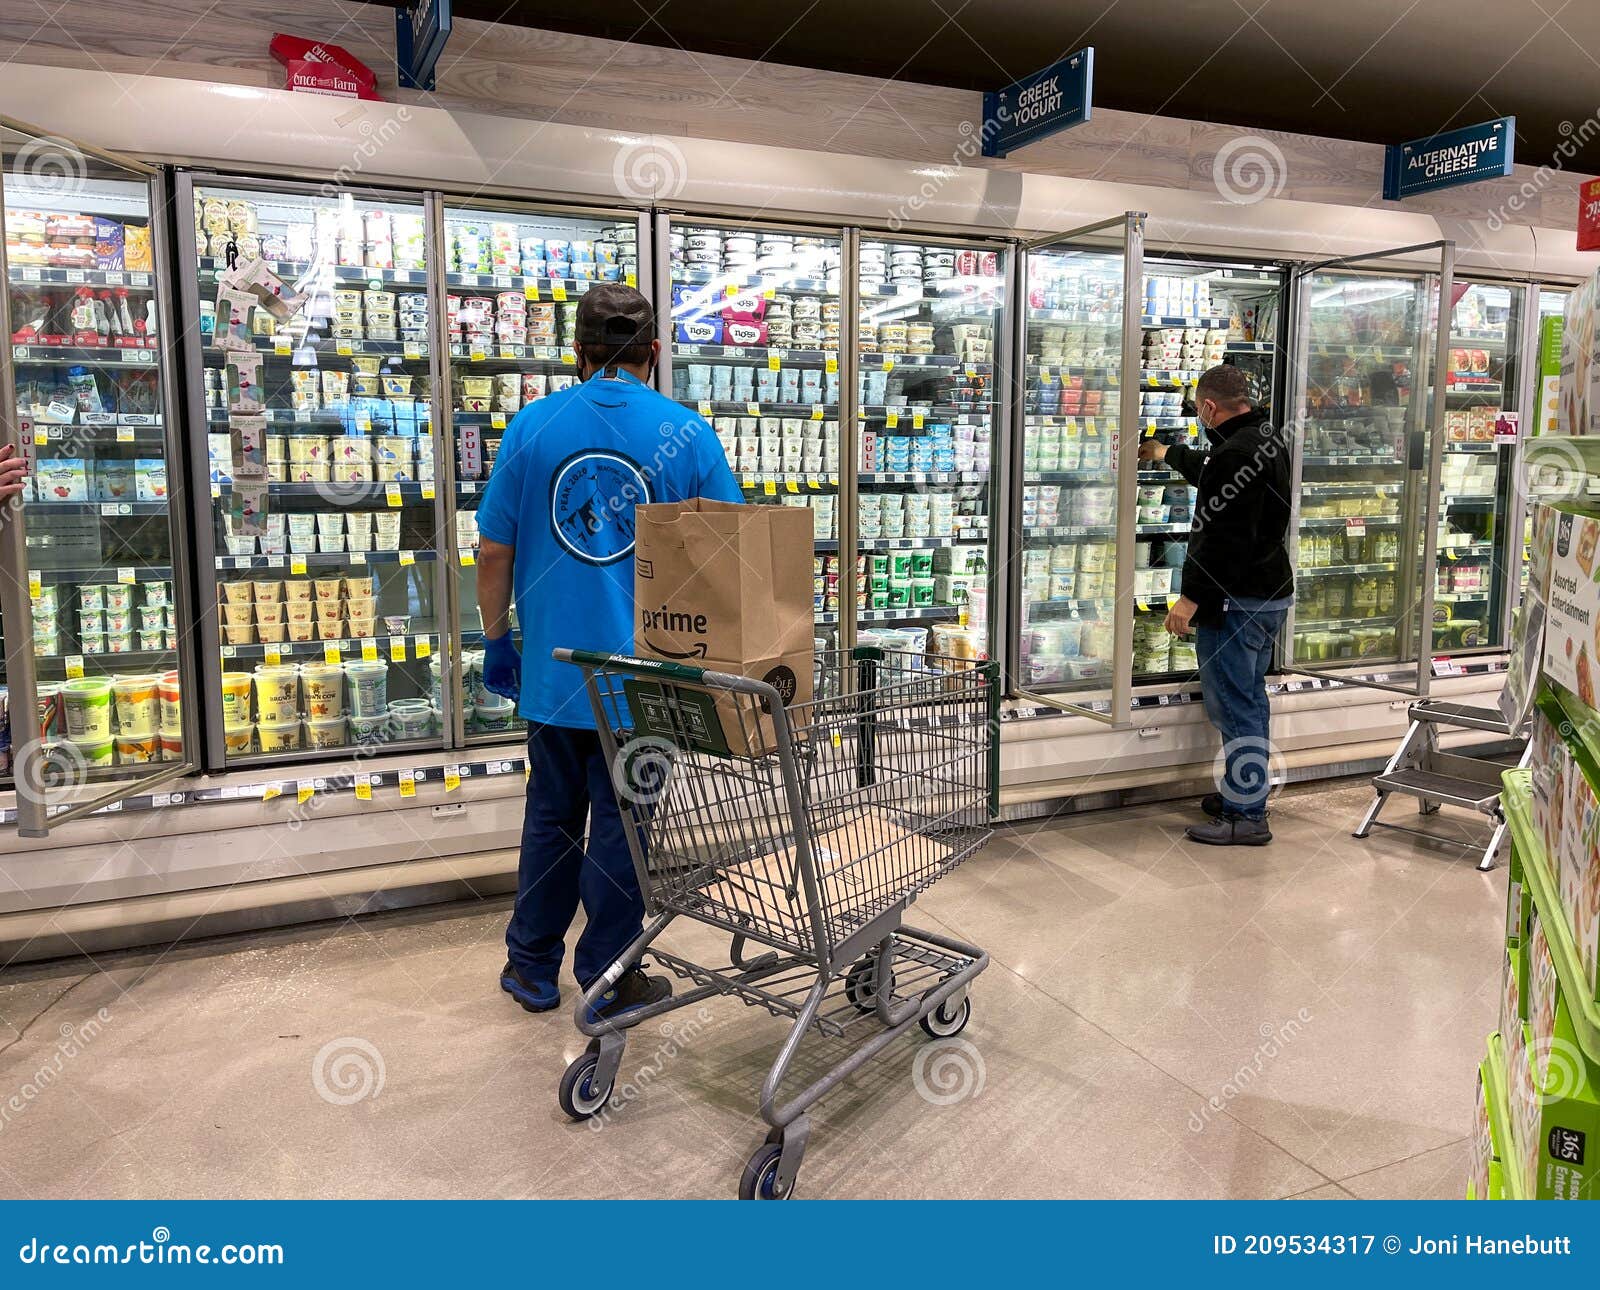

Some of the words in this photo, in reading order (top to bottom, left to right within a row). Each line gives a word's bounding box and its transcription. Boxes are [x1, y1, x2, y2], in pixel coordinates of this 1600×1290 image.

[1018, 75, 1059, 108] GREEK
[1013, 91, 1063, 127] YOGURT
[1408, 136, 1498, 169] ALTERNATIVE
[1425, 154, 1477, 178] CHEESE
[690, 327, 712, 336] noosa
[734, 329, 756, 338] noosa
[465, 431, 476, 469] PULL
[865, 436, 873, 469] PULL
[560, 486, 572, 512] PEAK
[568, 466, 588, 486] 2020
[1553, 569, 1578, 595] Assorted
[642, 605, 708, 635] prime
[1551, 592, 1591, 625] Entertainment
[1560, 1130, 1581, 1161] 365
